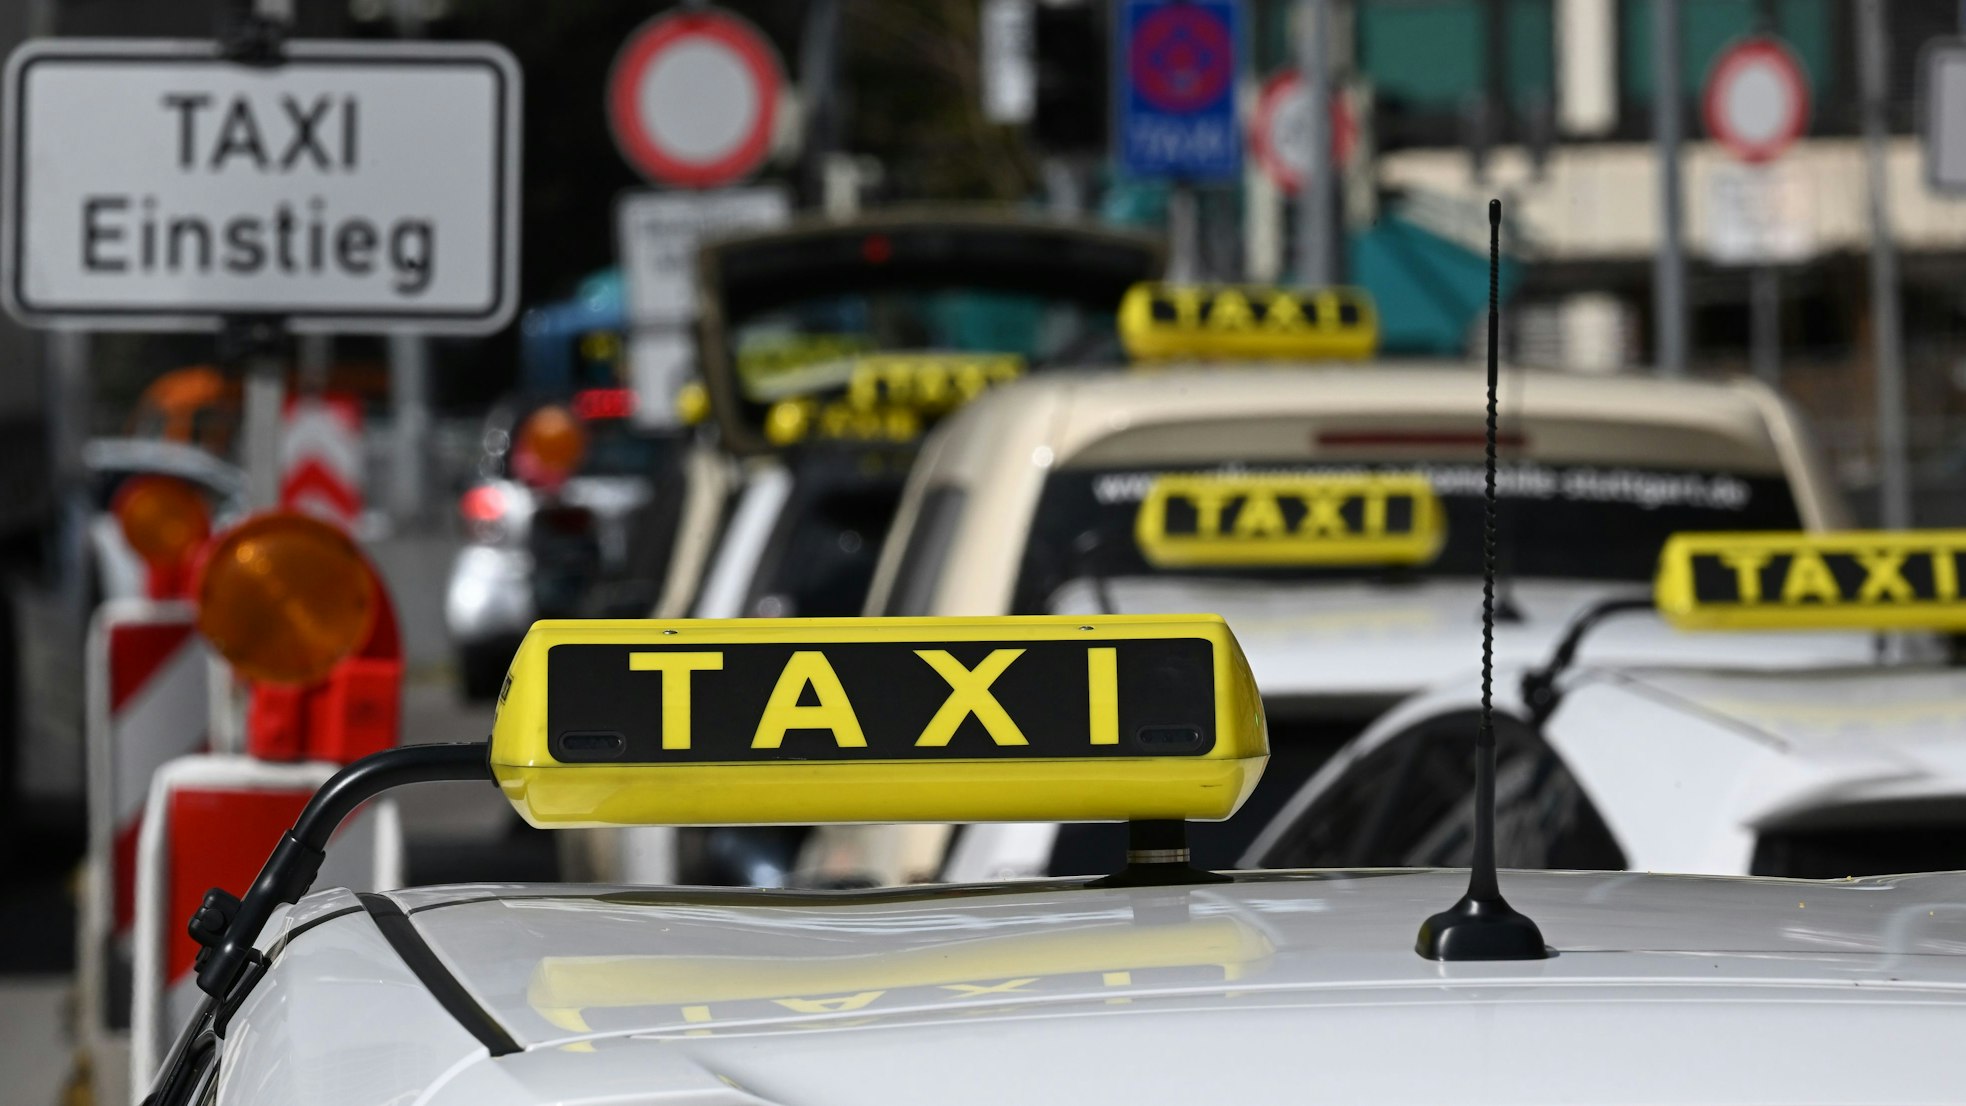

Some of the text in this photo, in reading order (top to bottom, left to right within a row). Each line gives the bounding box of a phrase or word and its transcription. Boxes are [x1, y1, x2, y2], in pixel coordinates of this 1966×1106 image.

[161, 93, 359, 172] TAXI
[80, 194, 435, 297] Einstieg
[1168, 287, 1341, 329] TAXI
[1186, 488, 1387, 536] TAXI
[1718, 548, 1960, 602] TAXI
[628, 647, 1120, 750] TAXI
